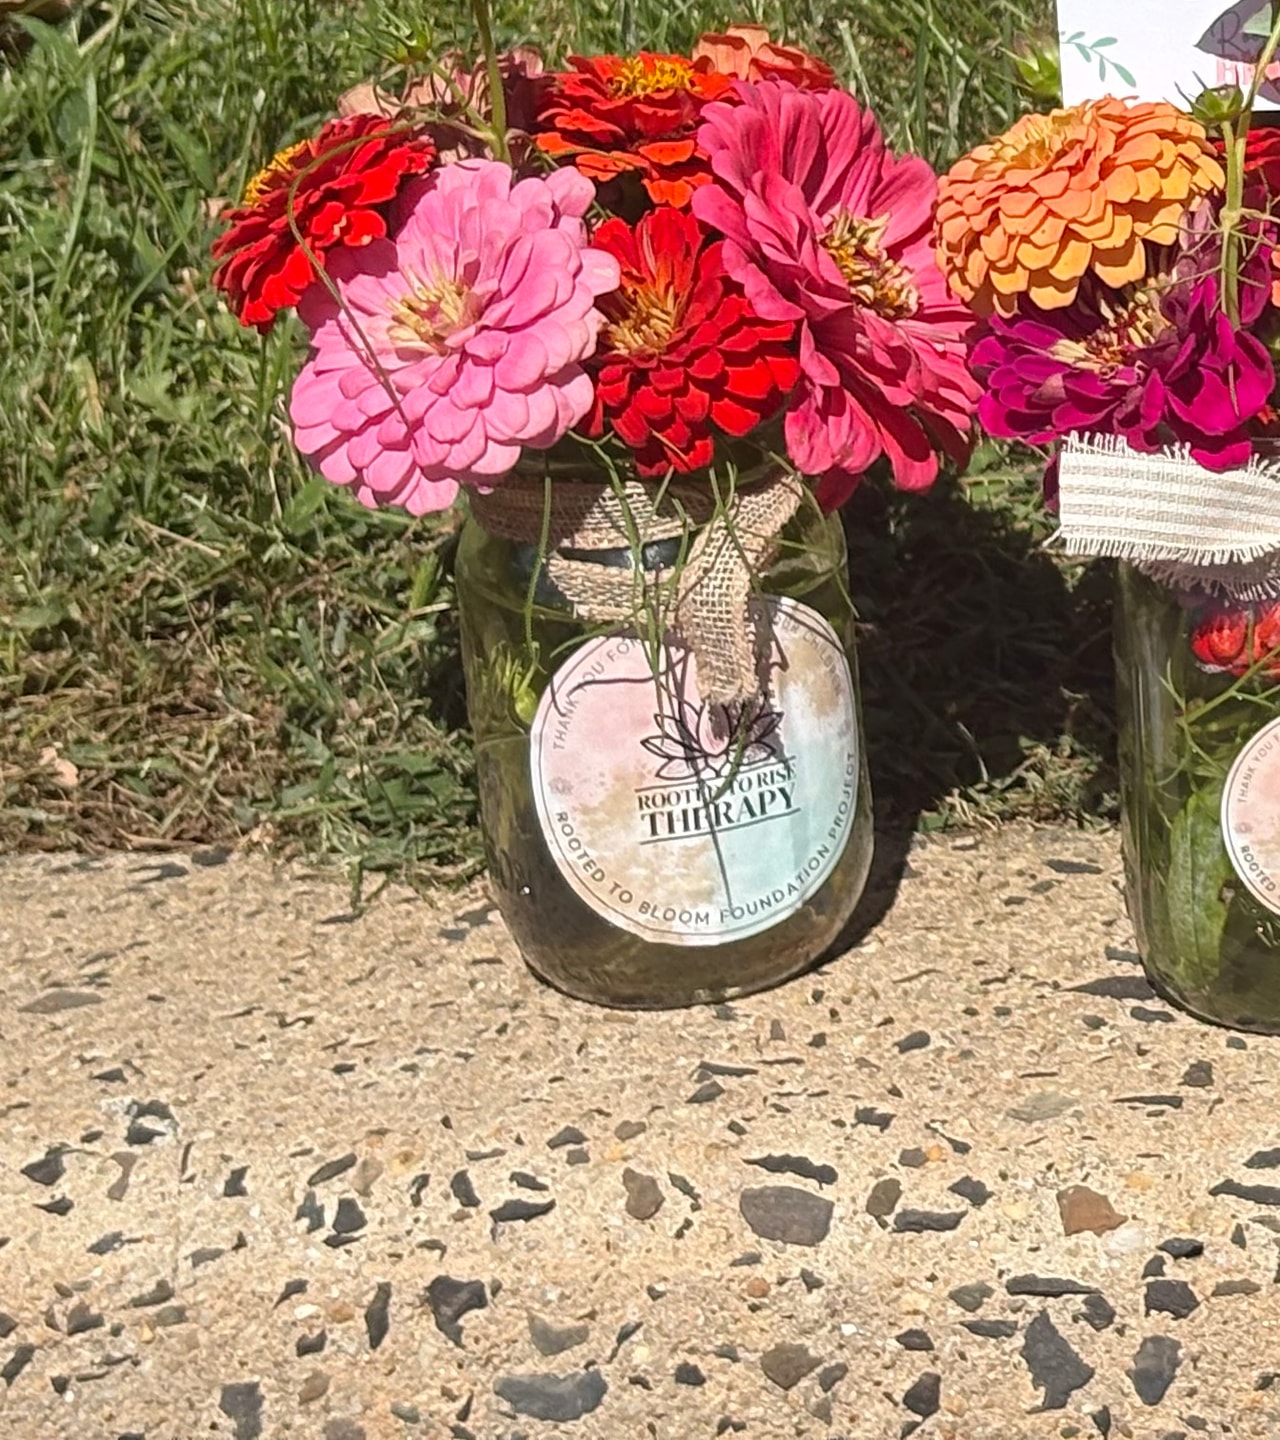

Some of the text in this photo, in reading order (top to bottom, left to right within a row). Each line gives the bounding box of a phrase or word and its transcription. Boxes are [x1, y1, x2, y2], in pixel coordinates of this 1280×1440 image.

[552, 695, 580, 750] THANK
[1237, 764, 1255, 804] THANK
[1252, 744, 1273, 762] YOU
[555, 752, 856, 926] ROOTED TO BLOOM FOUNDATION PROJECT
[641, 785, 795, 838] THERAPY
[1240, 845, 1275, 892] ROOTED
